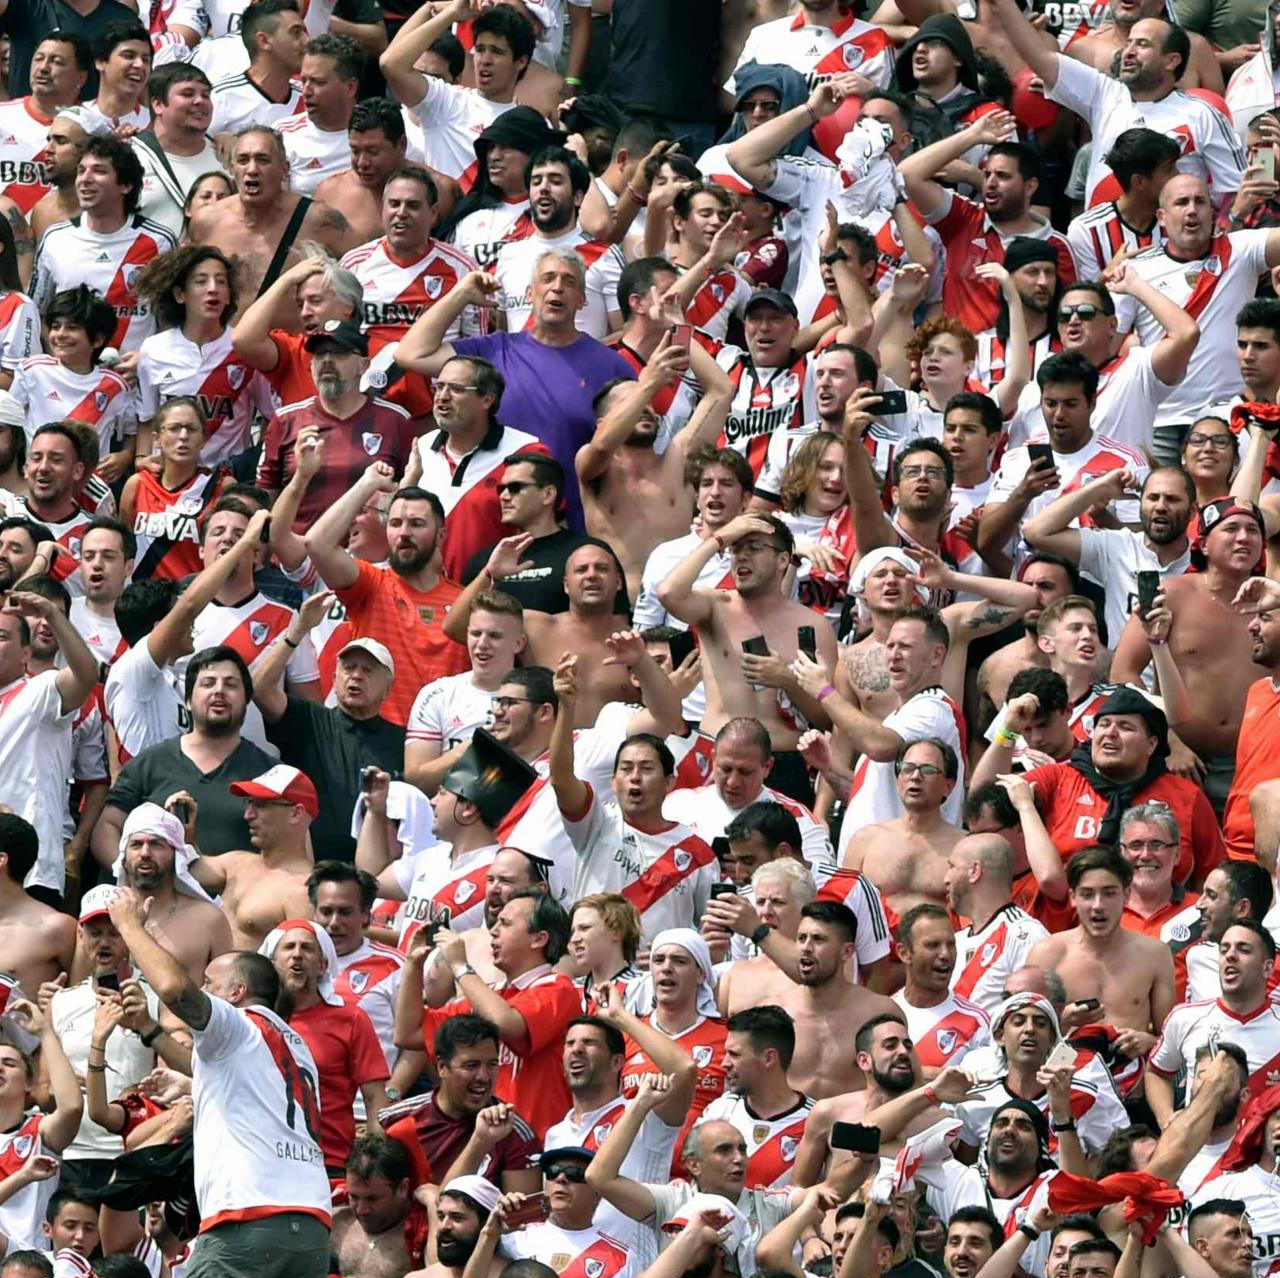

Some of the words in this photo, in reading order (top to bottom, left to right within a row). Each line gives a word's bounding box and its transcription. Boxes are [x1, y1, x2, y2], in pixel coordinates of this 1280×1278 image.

[0, 160, 48, 186] BBV
[362, 303, 428, 324] BBV
[133, 510, 199, 543] BBVA
[285, 1055, 321, 1139] 10
